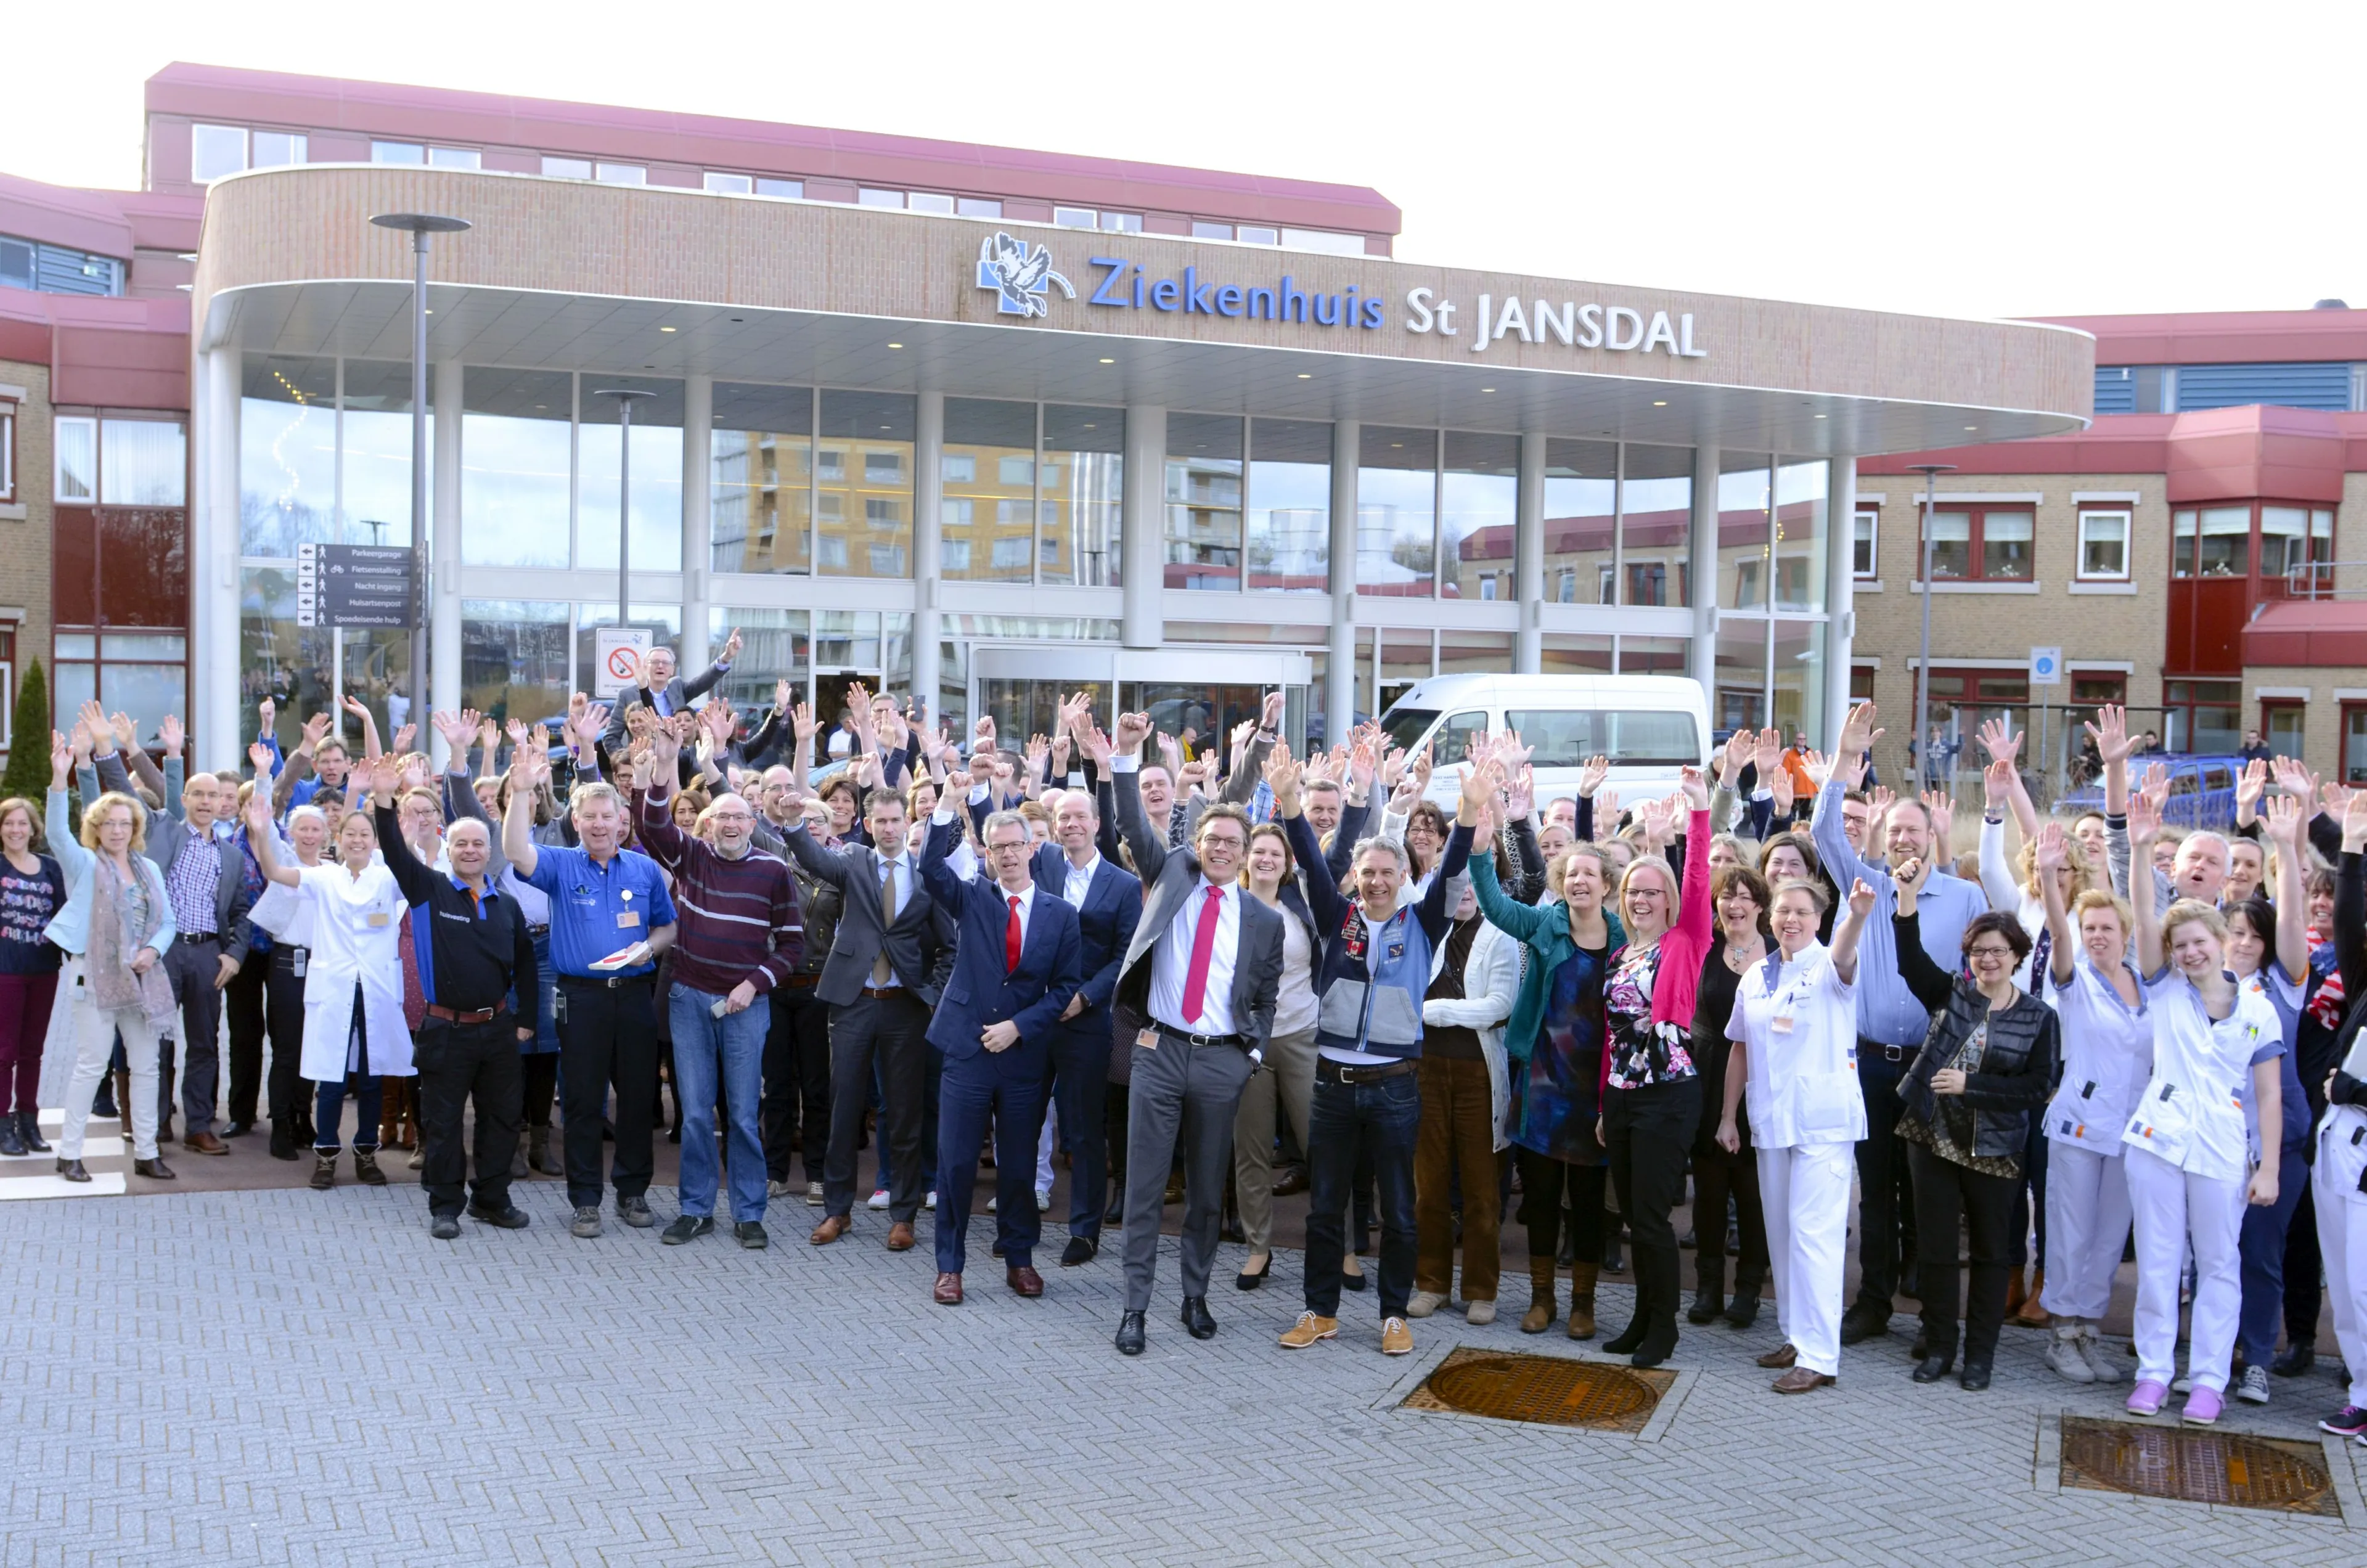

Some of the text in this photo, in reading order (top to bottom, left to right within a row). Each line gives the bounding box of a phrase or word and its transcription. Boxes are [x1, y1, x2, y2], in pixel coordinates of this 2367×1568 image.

[1089, 256, 1707, 357] Ziekenhuis St JANSDAL
[351, 549, 402, 559] Parkeergarage
[351, 565, 402, 576] Fietsenstalling
[354, 582, 402, 592] Nacht ingang
[348, 598, 402, 608] Huisartsenpost
[334, 615, 401, 625] Spoedeisende hulp
[439, 910, 470, 923] huisvesting
